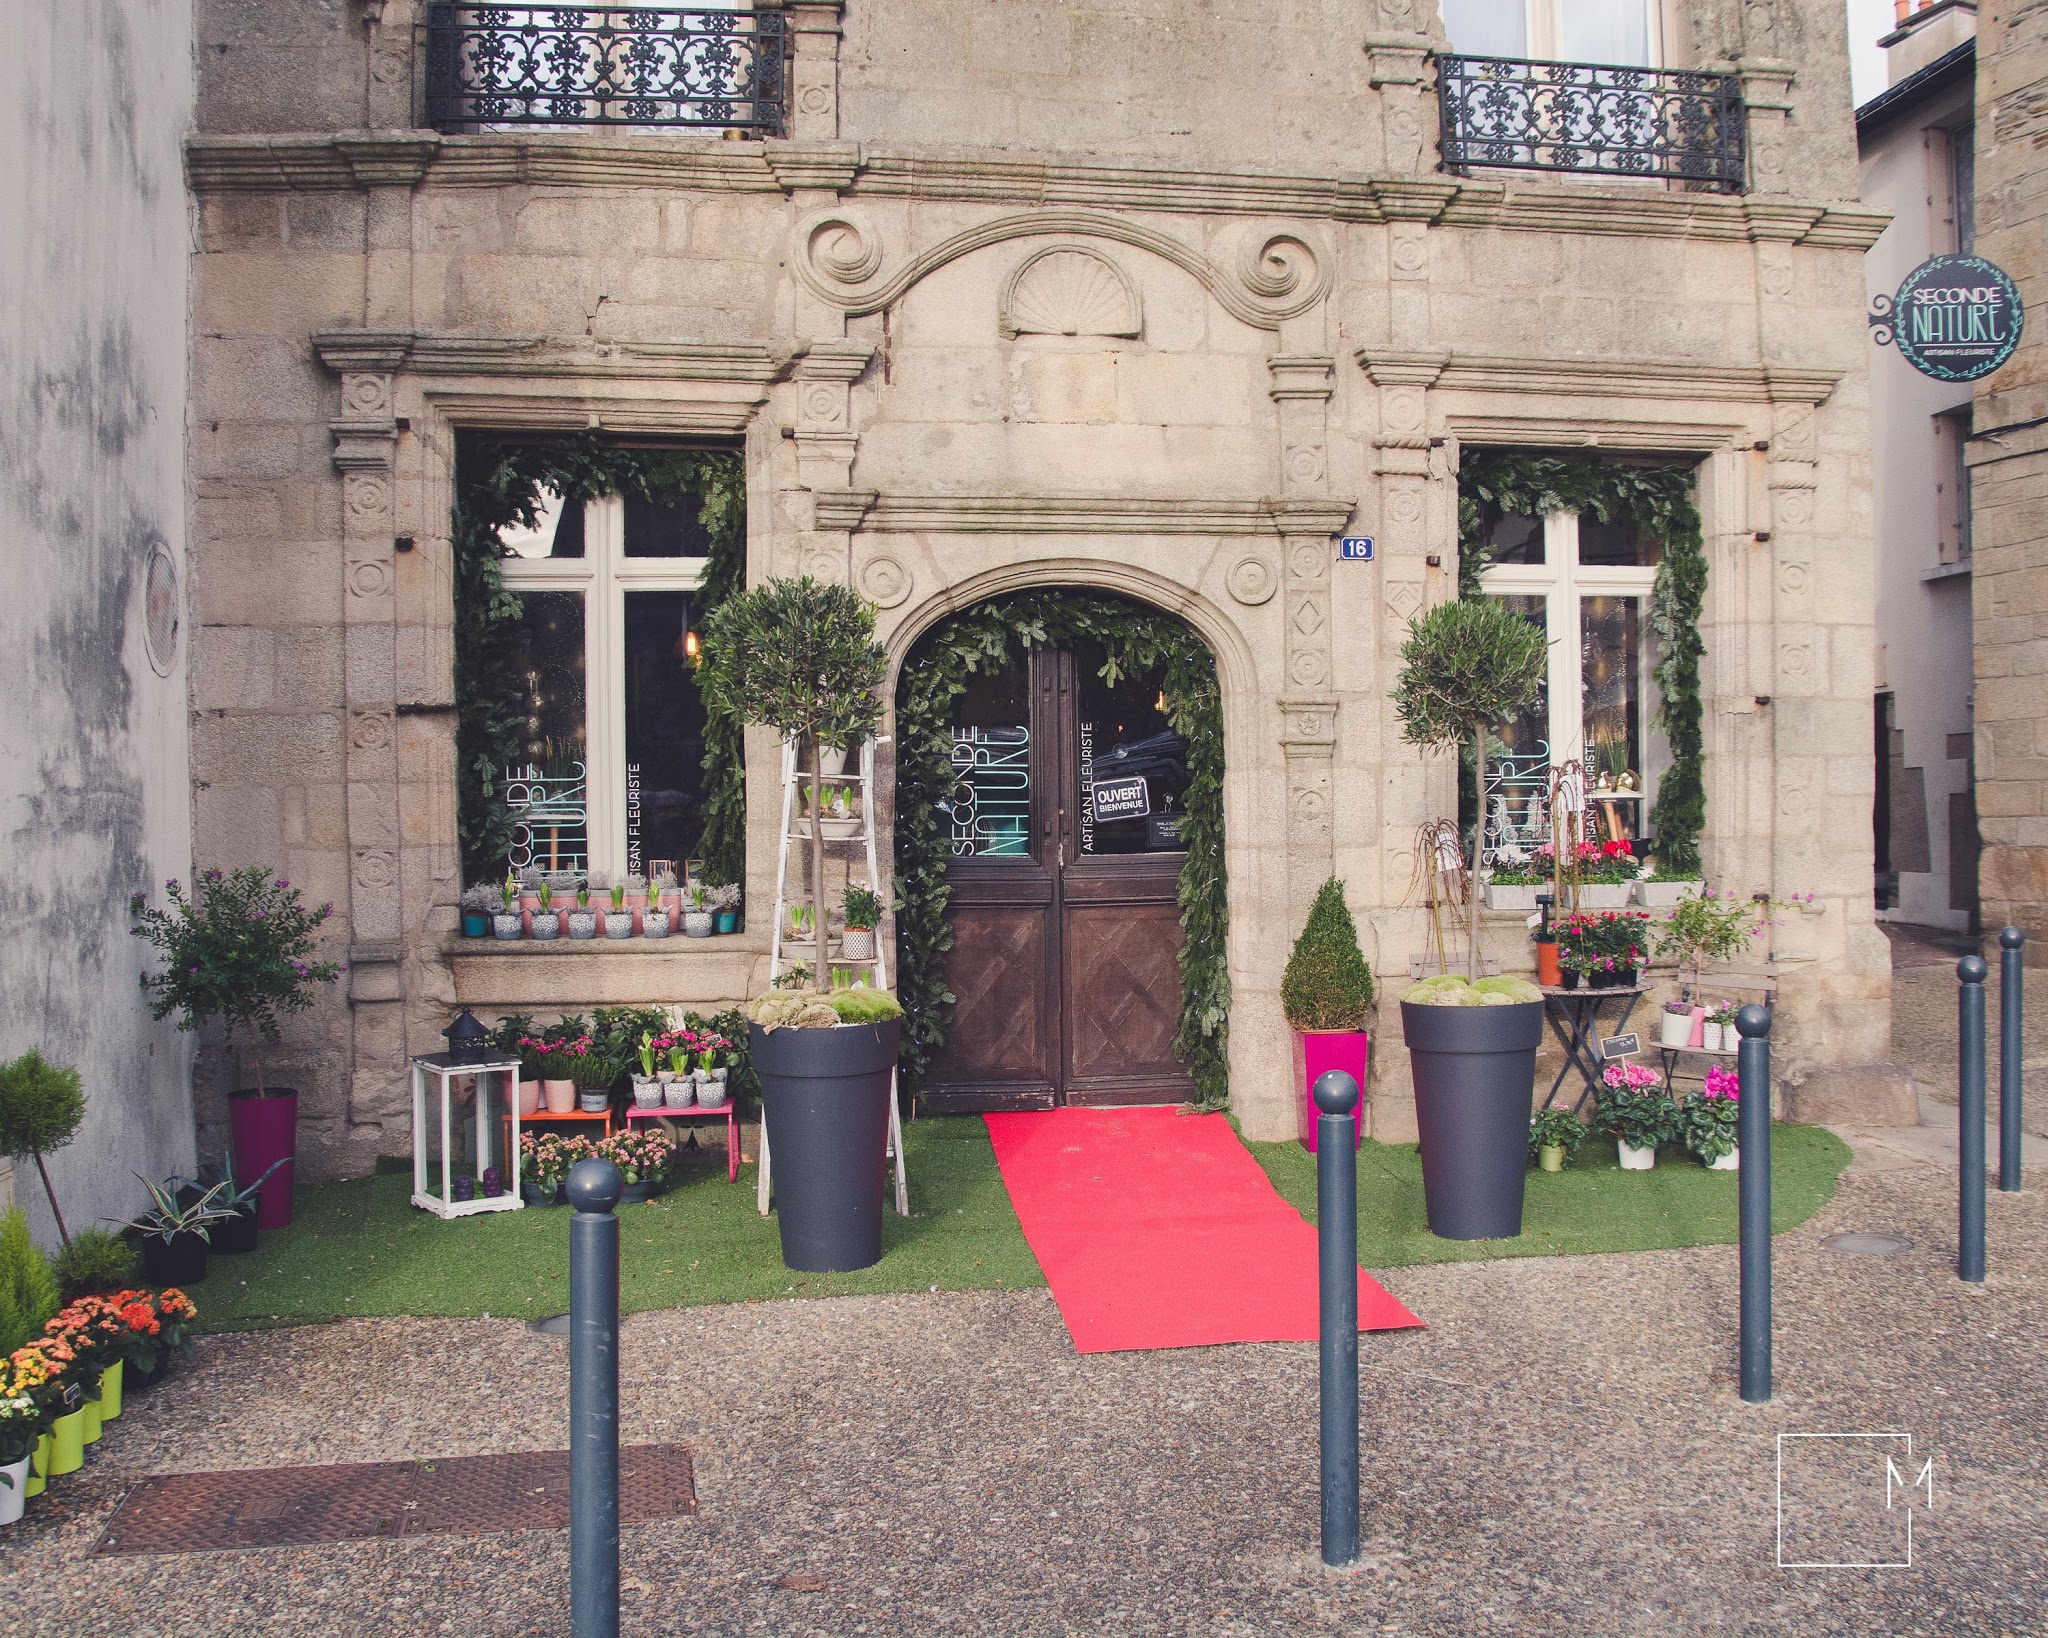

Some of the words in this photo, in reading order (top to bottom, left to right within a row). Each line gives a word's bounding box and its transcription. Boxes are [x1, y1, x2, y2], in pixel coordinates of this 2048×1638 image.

[1912, 286, 2003, 305] SECONDE
[1912, 303, 2006, 343] NATURE
[1955, 348, 1996, 356] FLEURISTE
[1348, 540, 1367, 557] 16
[1081, 722, 1093, 792] FLEURISTE
[628, 763, 641, 836] FLEURISTE
[951, 725, 975, 856] SECONDE
[974, 725, 1029, 856] NATURE
[1097, 786, 1142, 804] OUVERT
[1099, 799, 1144, 813] BIENVENUE
[1482, 755, 1503, 865] SECOND
[529, 761, 588, 881] ATURE
[1081, 796, 1094, 852] ARTISAN
